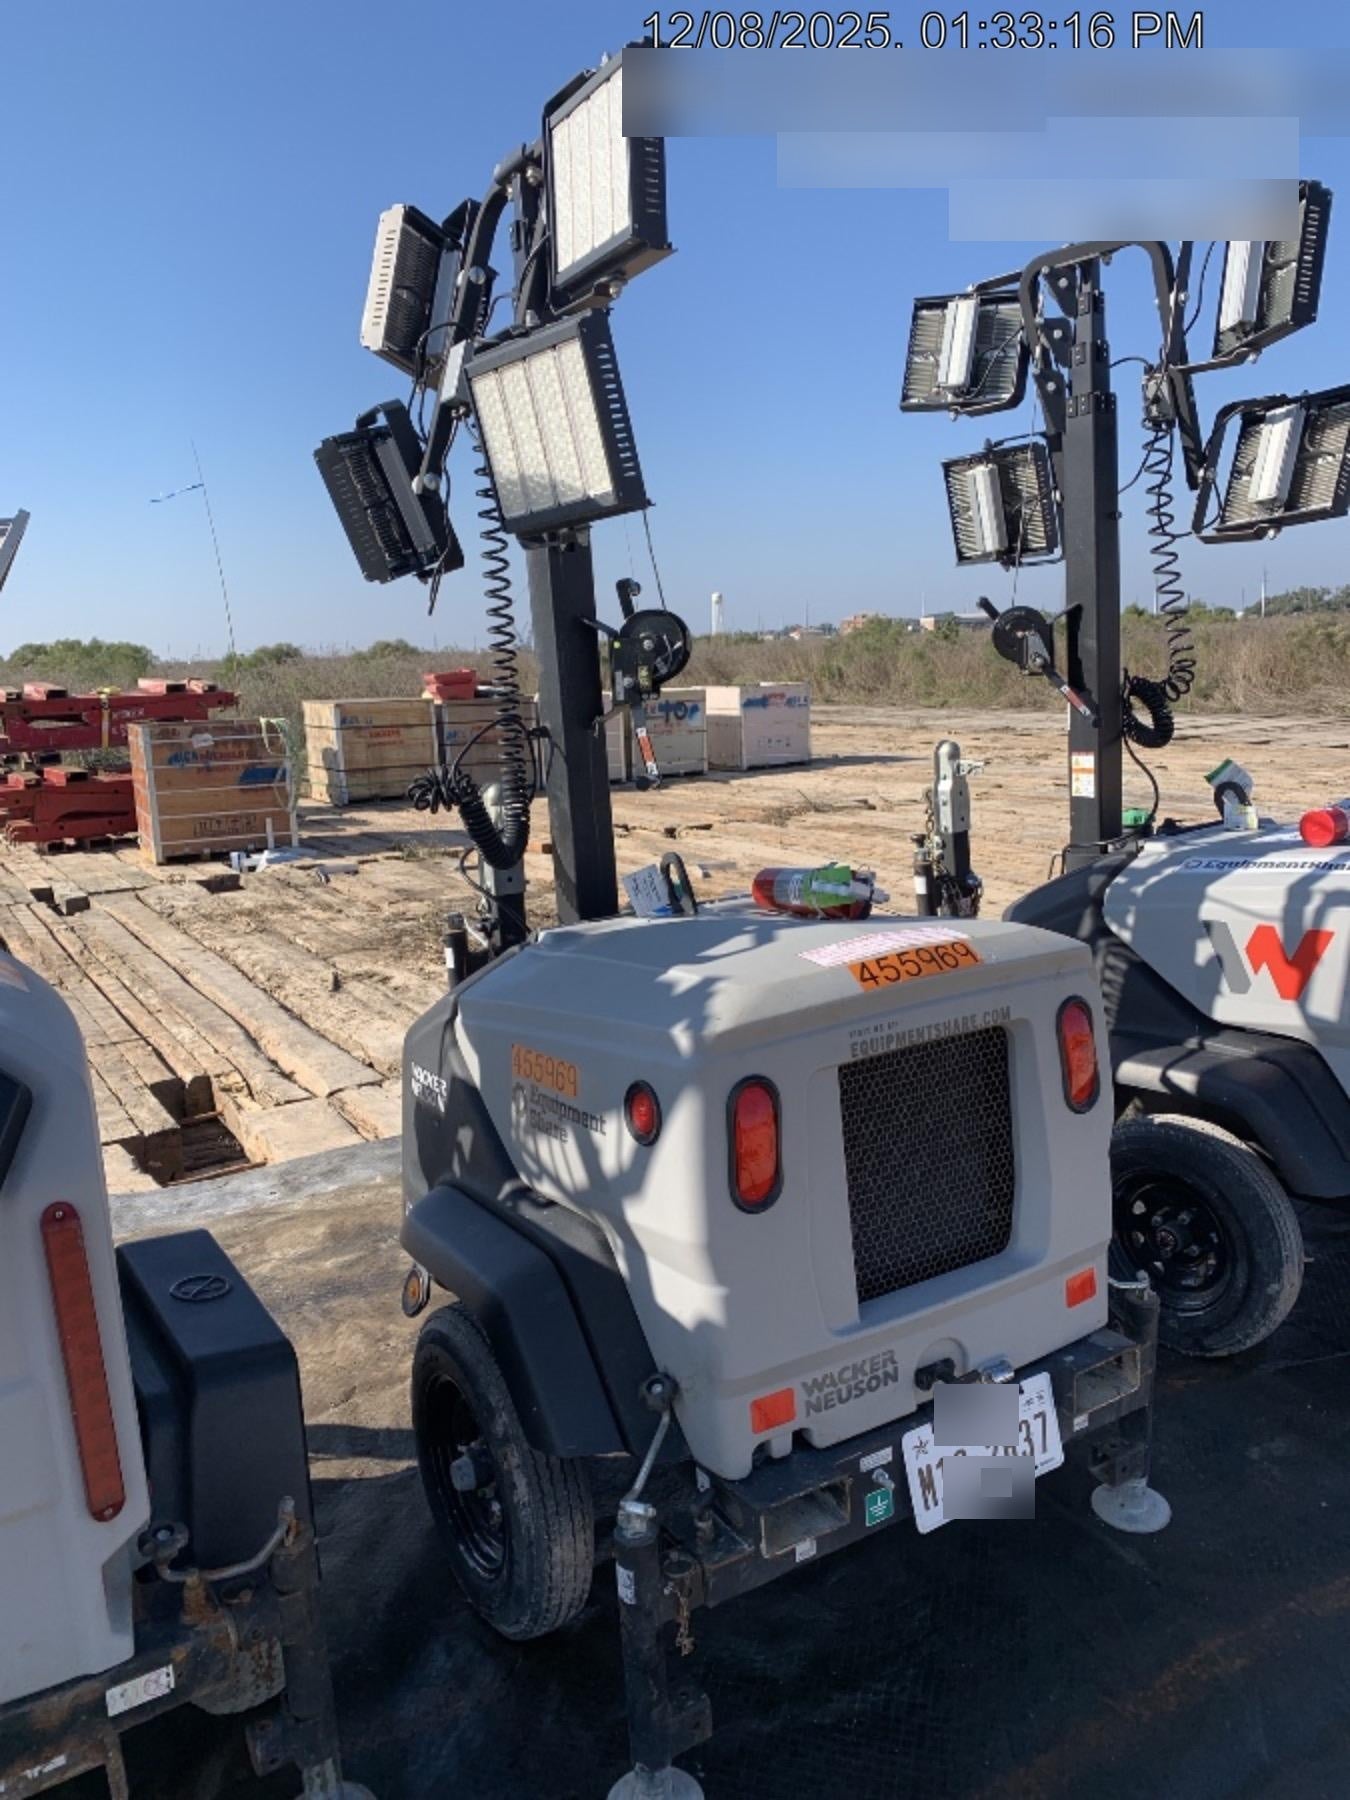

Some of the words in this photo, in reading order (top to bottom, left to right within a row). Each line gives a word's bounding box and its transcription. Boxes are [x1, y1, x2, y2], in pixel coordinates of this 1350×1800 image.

[859, 941, 979, 986] 455969
[849, 1005, 1011, 1060] EQUIPMENTSHARE.COM
[512, 1045, 578, 1097] 455969
[801, 1349, 898, 1398] WACKER
[805, 1365, 899, 1419] NEUSON
